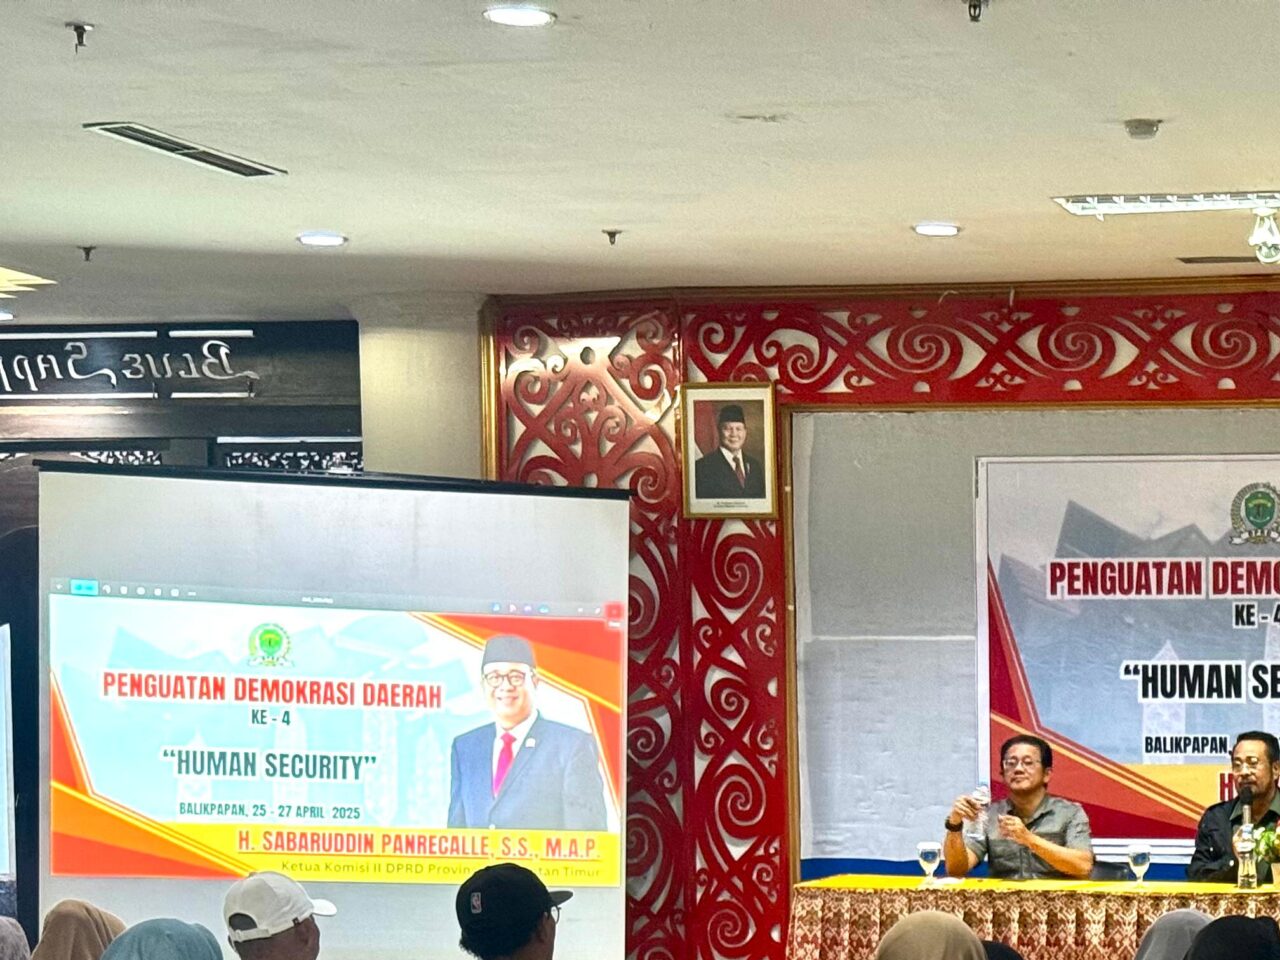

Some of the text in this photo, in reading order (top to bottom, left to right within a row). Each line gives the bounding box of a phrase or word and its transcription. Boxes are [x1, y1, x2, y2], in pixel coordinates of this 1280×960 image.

[1049, 560, 1203, 596] PENGUATAN
[1234, 603, 1256, 626] KE
[102, 671, 442, 709] PENGUATAN DEMOKRASI DAERAH
[251, 708, 267, 725] KE
[281, 710, 291, 726] 4
[1144, 736, 1232, 756] BALIKPAPAN,
[179, 802, 249, 817] BALIKPAPAN,
[252, 804, 267, 817] 25
[278, 804, 292, 818] 27
[295, 805, 325, 819] APRIL
[332, 806, 361, 820] 2025
[238, 830, 601, 860] H. SABARUDDIN PANRECALLE, S.S., M.A.P.
[281, 861, 320, 872] Ketua
[324, 861, 369, 873] Komisi
[386, 863, 424, 874] DPRD
[564, 866, 600, 877] Timur
